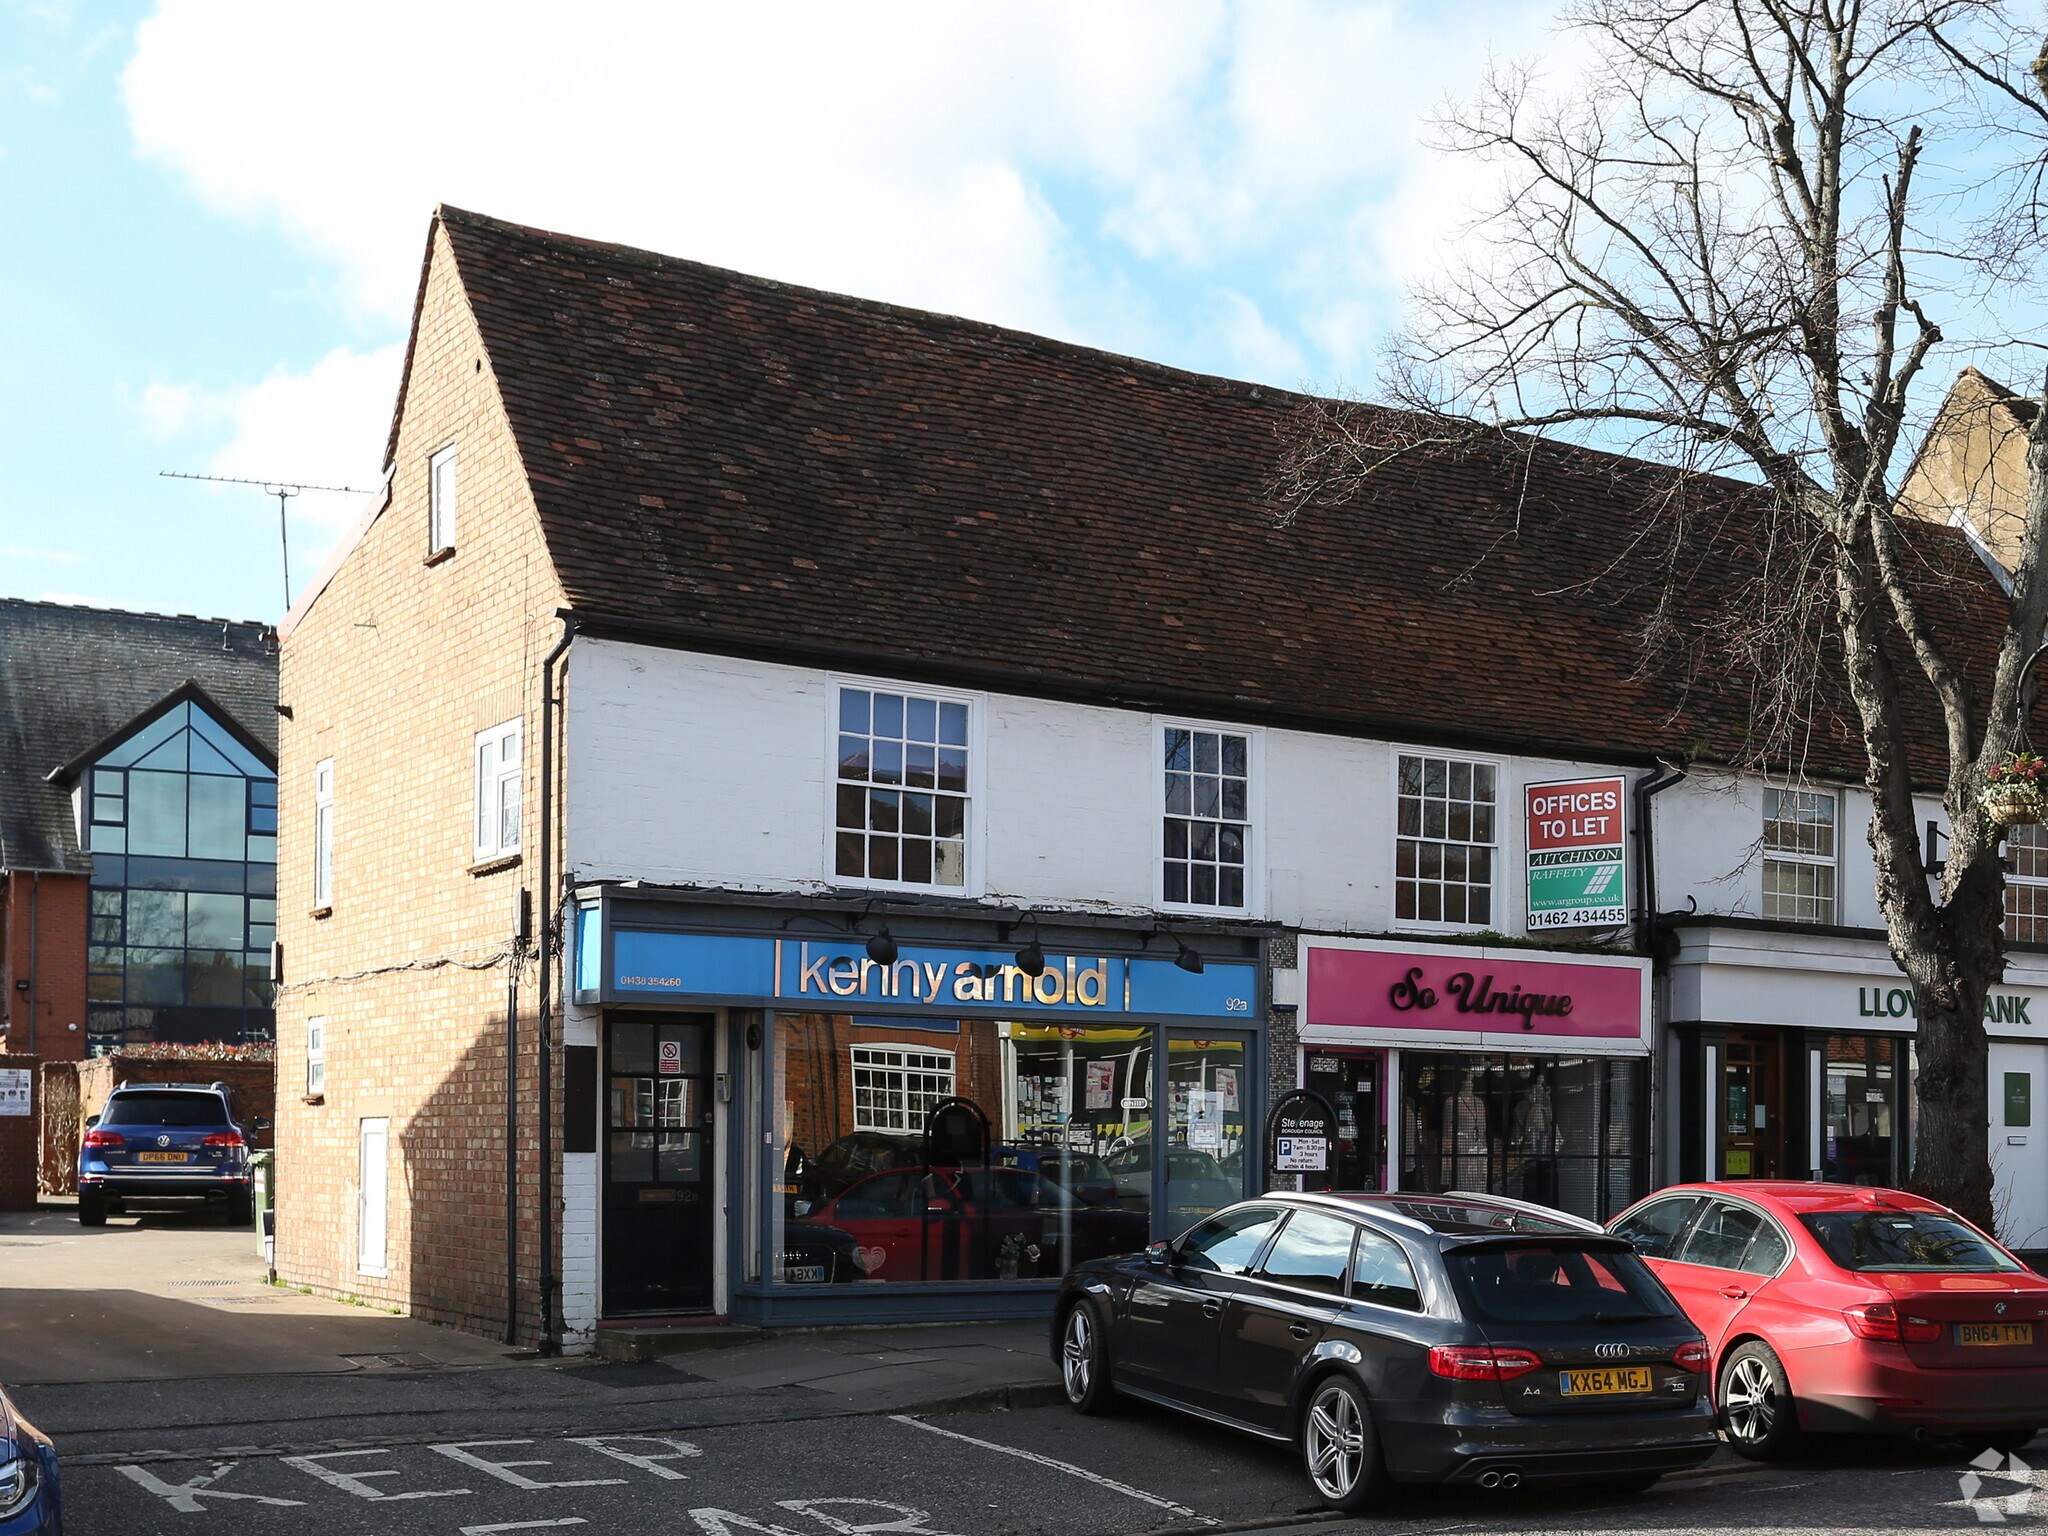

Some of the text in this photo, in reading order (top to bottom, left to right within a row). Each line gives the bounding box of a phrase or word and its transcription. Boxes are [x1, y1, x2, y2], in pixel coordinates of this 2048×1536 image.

[1532, 791, 1618, 816] OFFICES
[1540, 816, 1610, 839] TO LET
[1532, 848, 1621, 866] AITCHISON
[1532, 867, 1589, 881] RAFFETY
[1532, 894, 1620, 907] www.argroup.co.uk
[1529, 908, 1625, 926] 01462 434455
[620, 975, 682, 987] 01438 354260
[1226, 998, 1248, 1011] 92a
[1390, 967, 1574, 1030] So Unique
[1859, 987, 2032, 1025] LLOY ANK
[1281, 1141, 1290, 1154] P
[1962, 1324, 2029, 1343] BN64 TTY
[1569, 1370, 1650, 1393] KX64 MGJ
[1523, 1386, 1541, 1396] A4
[112, 1436, 703, 1512] KEEP
